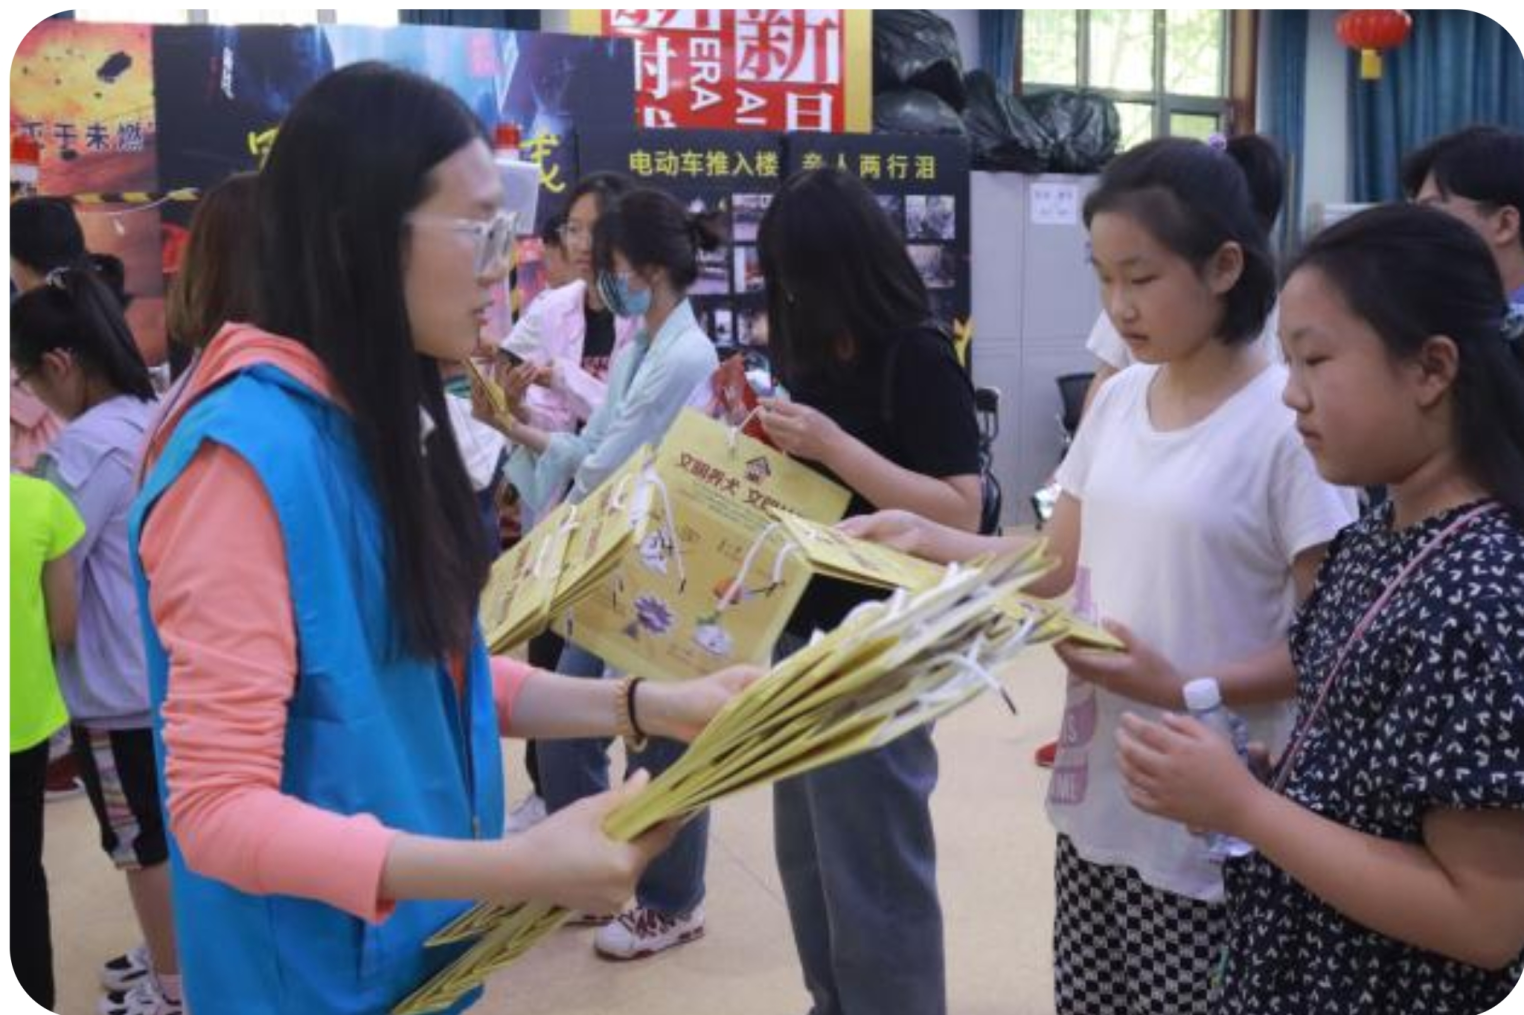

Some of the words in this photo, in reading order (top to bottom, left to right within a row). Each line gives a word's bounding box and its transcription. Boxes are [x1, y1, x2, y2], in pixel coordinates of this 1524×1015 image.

[629, 150, 778, 177] 电动车推入楼
